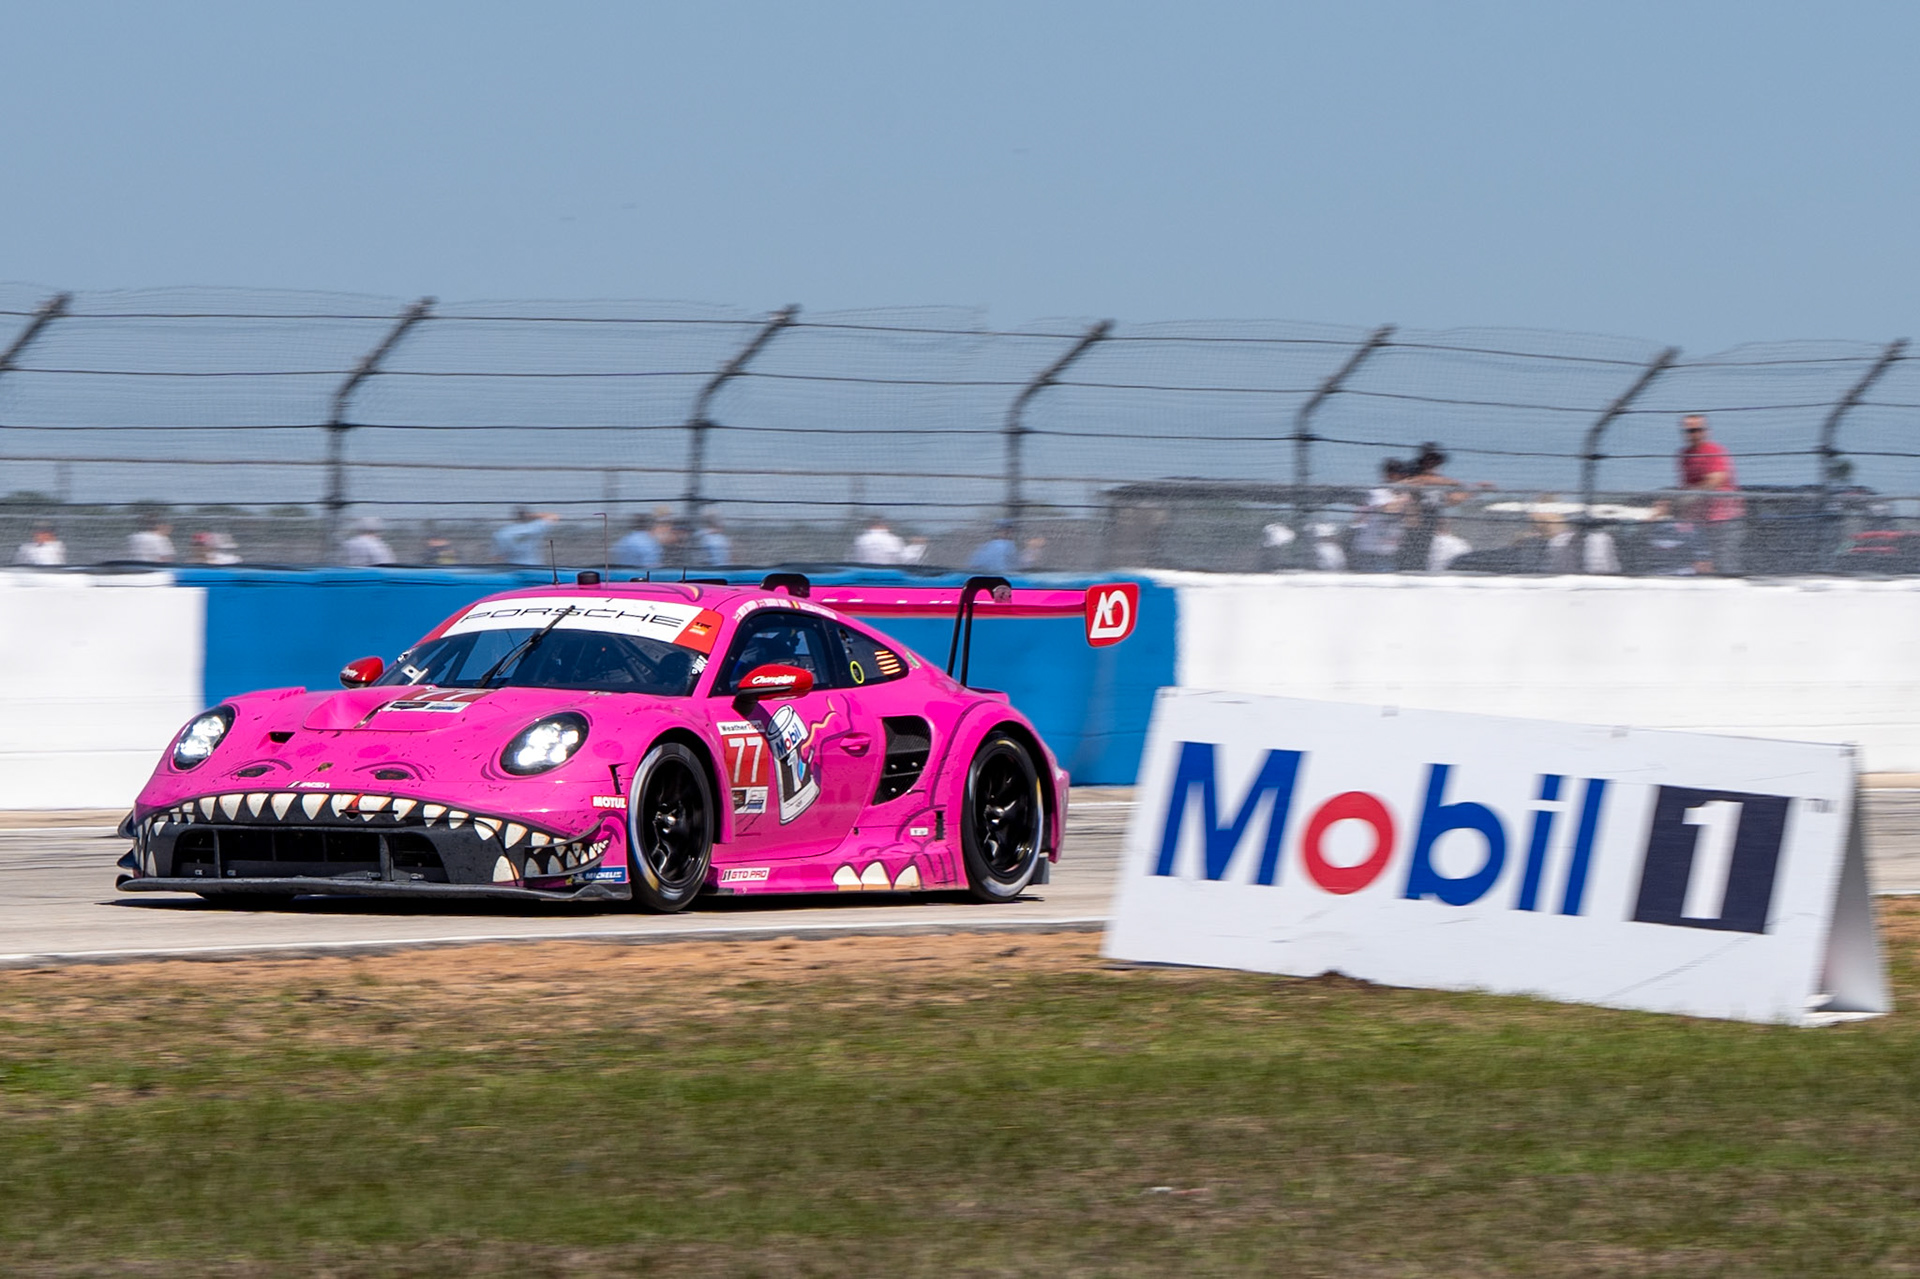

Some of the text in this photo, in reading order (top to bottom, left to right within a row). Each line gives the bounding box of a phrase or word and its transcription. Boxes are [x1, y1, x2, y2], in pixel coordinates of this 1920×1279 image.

[460, 607, 684, 629] PORSCHE
[776, 722, 802, 759] Mobil
[728, 737, 763, 784] 77
[593, 796, 626, 808] MOTUL
[1148, 741, 1744, 920] Mobil 1
